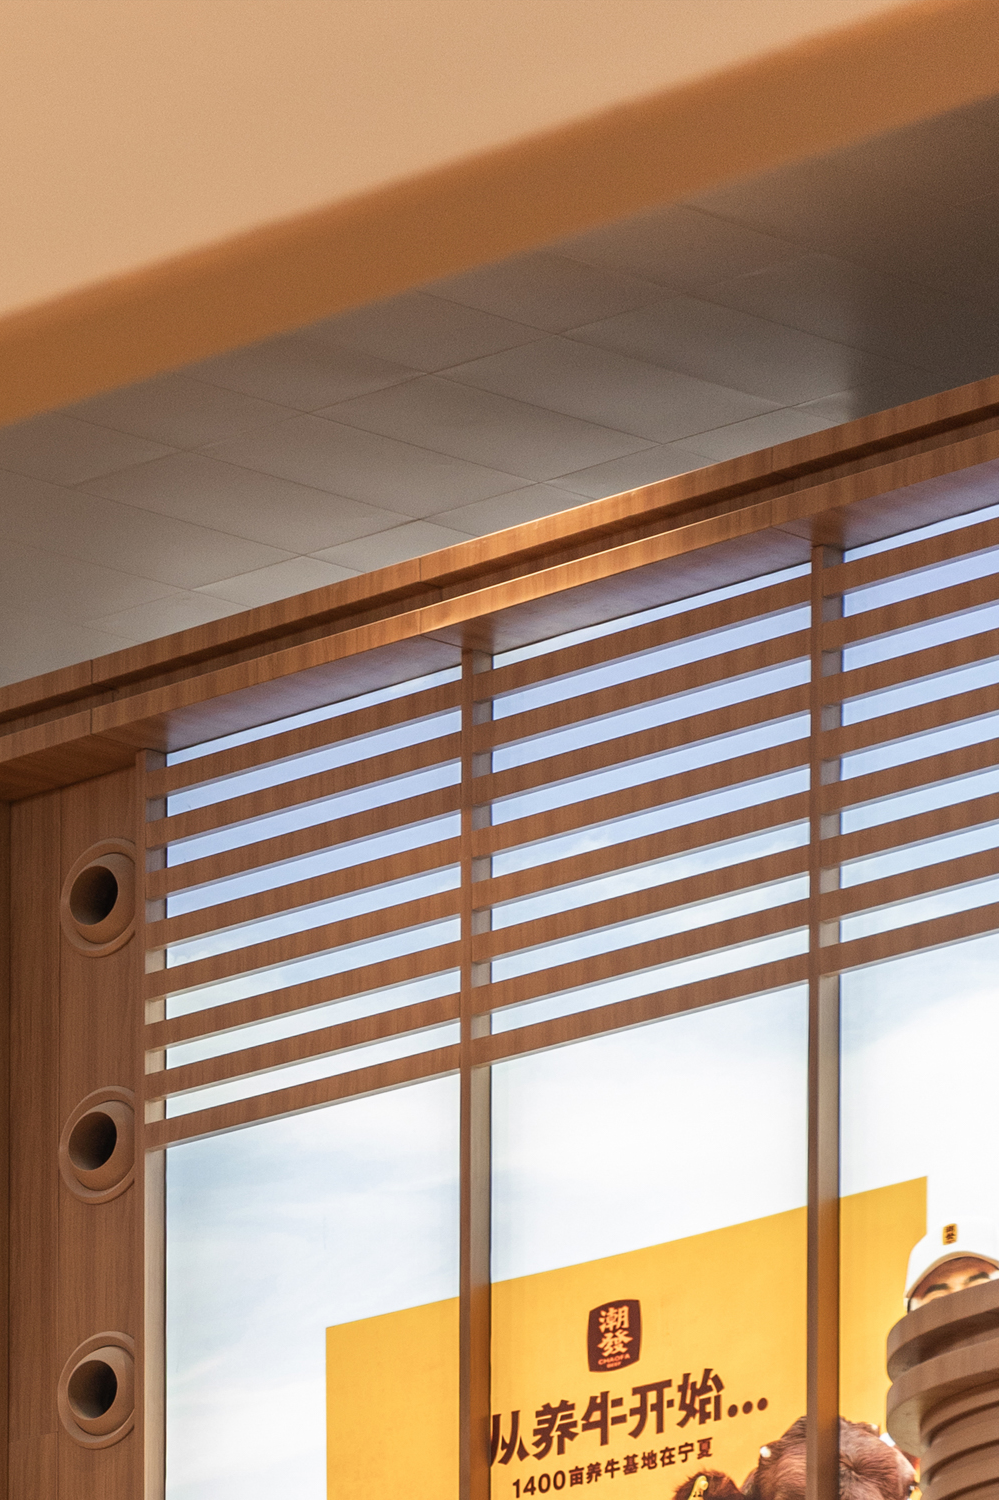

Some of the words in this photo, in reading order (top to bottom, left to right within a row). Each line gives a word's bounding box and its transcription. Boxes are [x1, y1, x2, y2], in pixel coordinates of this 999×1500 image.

[512, 1437, 714, 1499] 1400亩养牛基地在宁夏
